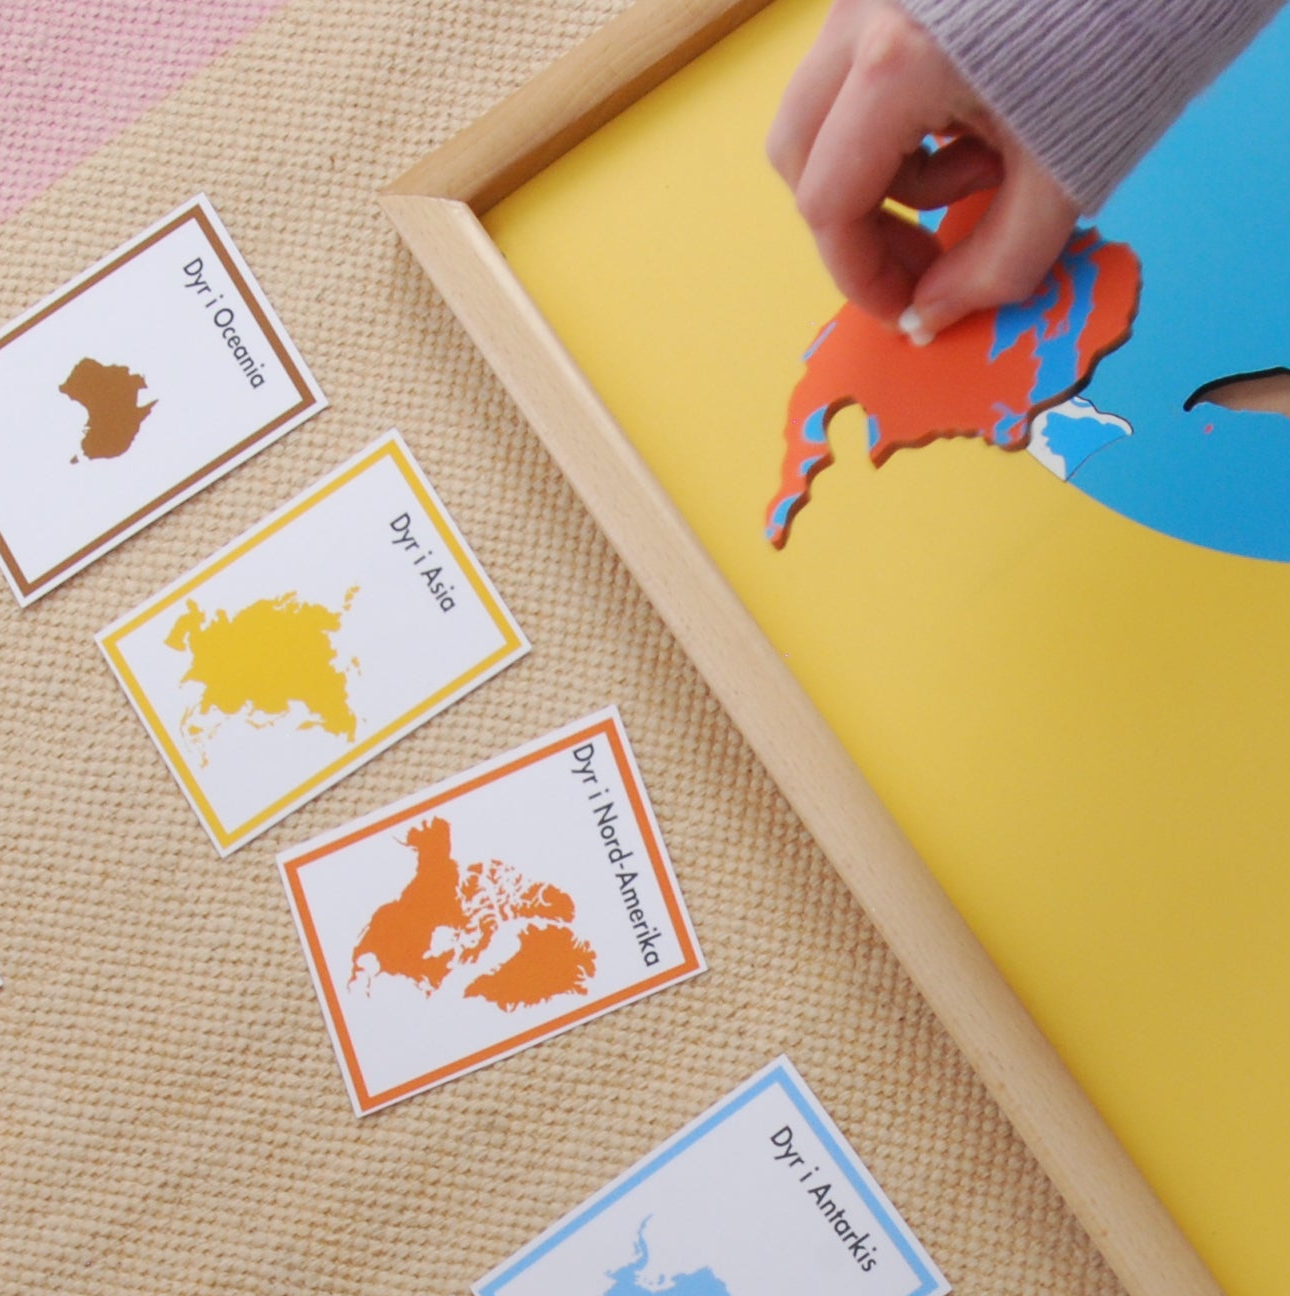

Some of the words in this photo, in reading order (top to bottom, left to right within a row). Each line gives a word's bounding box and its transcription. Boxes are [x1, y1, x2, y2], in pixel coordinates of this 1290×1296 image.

[183, 257, 212, 295] Dyr
[205, 294, 224, 308] i
[213, 308, 266, 390] Oceania
[390, 512, 420, 551] Dyr
[413, 550, 433, 565] i
[420, 567, 456, 613] Asia
[571, 743, 598, 784] Dyr
[588, 788, 610, 800] i
[593, 802, 662, 967] Nord-Amerika
[770, 1125, 805, 1167] Dyr
[799, 1166, 820, 1182] i
[807, 1183, 877, 1272] Antarkis
